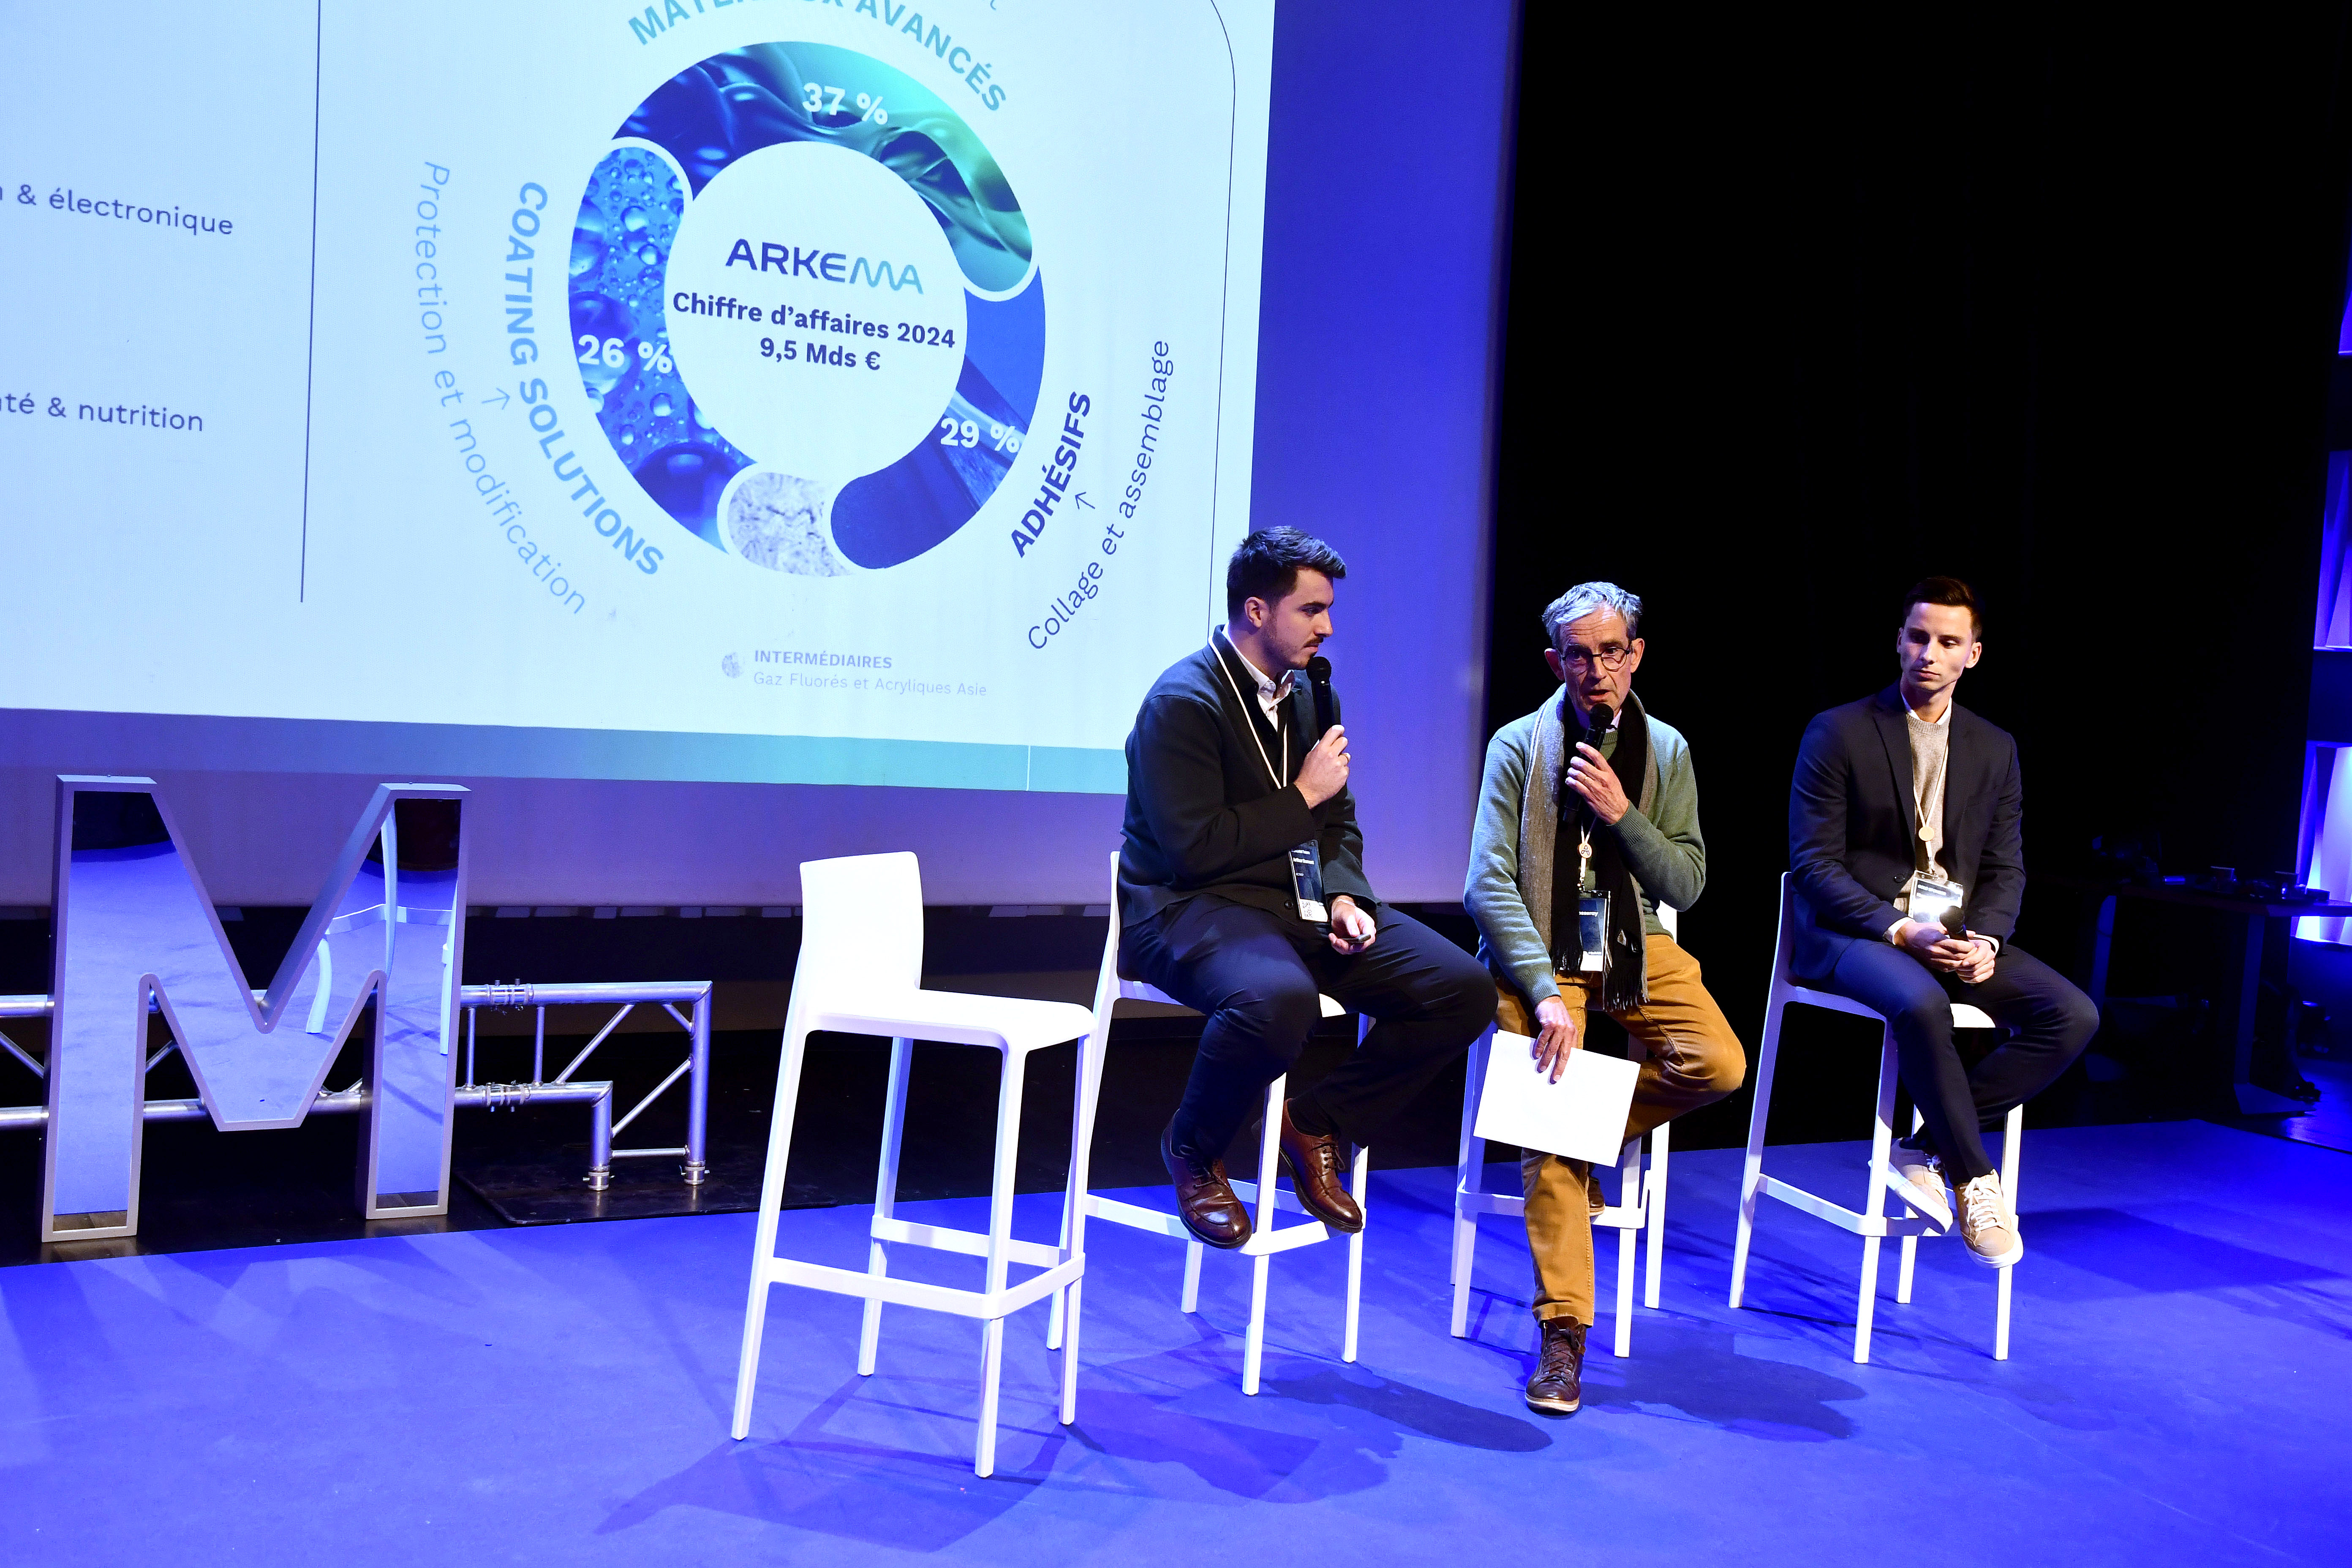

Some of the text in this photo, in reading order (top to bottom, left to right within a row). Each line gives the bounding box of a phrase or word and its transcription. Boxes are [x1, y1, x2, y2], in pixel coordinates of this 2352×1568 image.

[855, 0, 1006, 112] AVANCÉS
[802, 82, 889, 125] 37 %
[17, 184, 37, 206] &
[49, 188, 233, 235] électronique
[725, 238, 924, 294] ARKEMA
[673, 292, 956, 348] Chiffre d’affaires 2024
[505, 181, 664, 575] COATING SOLUTIONS
[578, 334, 673, 374] 26 %
[760, 338, 881, 370] 9,5 Mds €
[0, 393, 203, 432] té & nutrition
[415, 161, 586, 614] Protection et modification
[940, 417, 1020, 454] 29 %
[1010, 391, 1091, 558] ADHÉSIFS
[1028, 340, 1174, 650] Collage et assemblage
[754, 649, 893, 669] INTERMÉDIAIRES
[754, 671, 987, 696] Gaz Fluorés et Acryliques Asie
